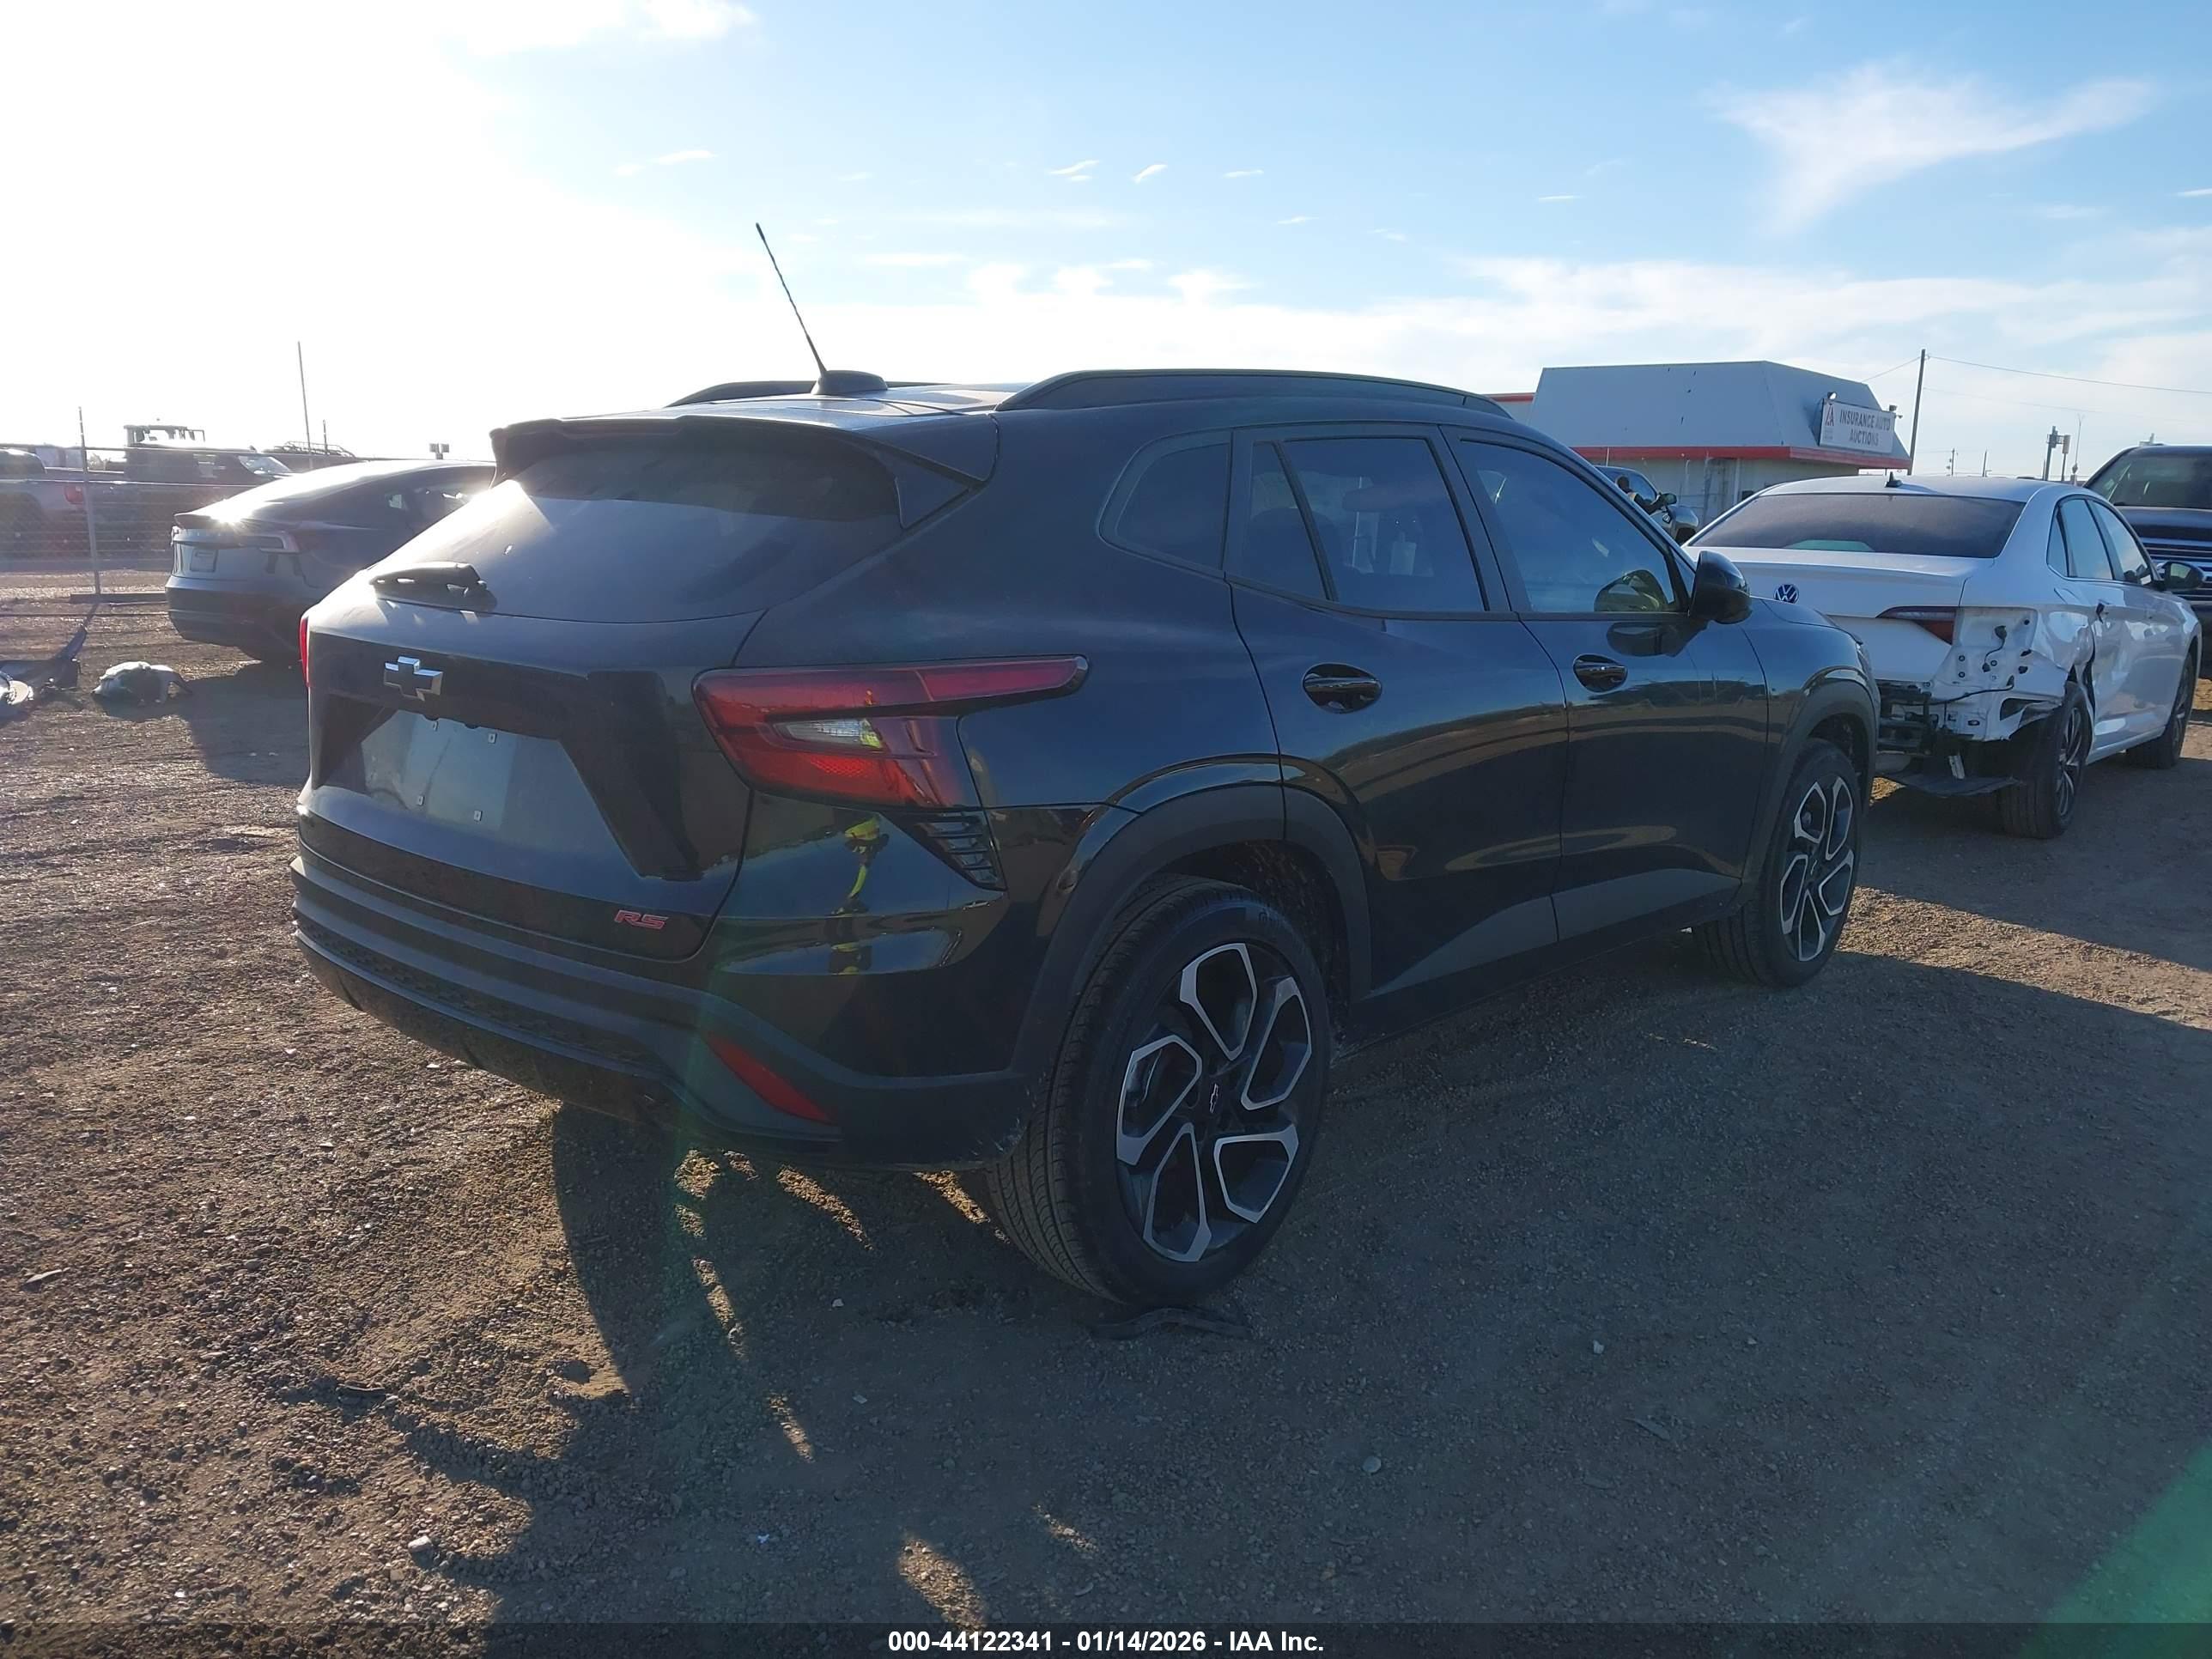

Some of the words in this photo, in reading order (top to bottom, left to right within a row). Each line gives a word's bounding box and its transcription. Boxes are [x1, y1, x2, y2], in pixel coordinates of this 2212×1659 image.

[1839, 409, 1875, 428] INSURANCE
[1875, 416, 1891, 431] AUTO
[1849, 428, 1879, 447] AUCTIONS
[614, 909, 669, 929] RS
